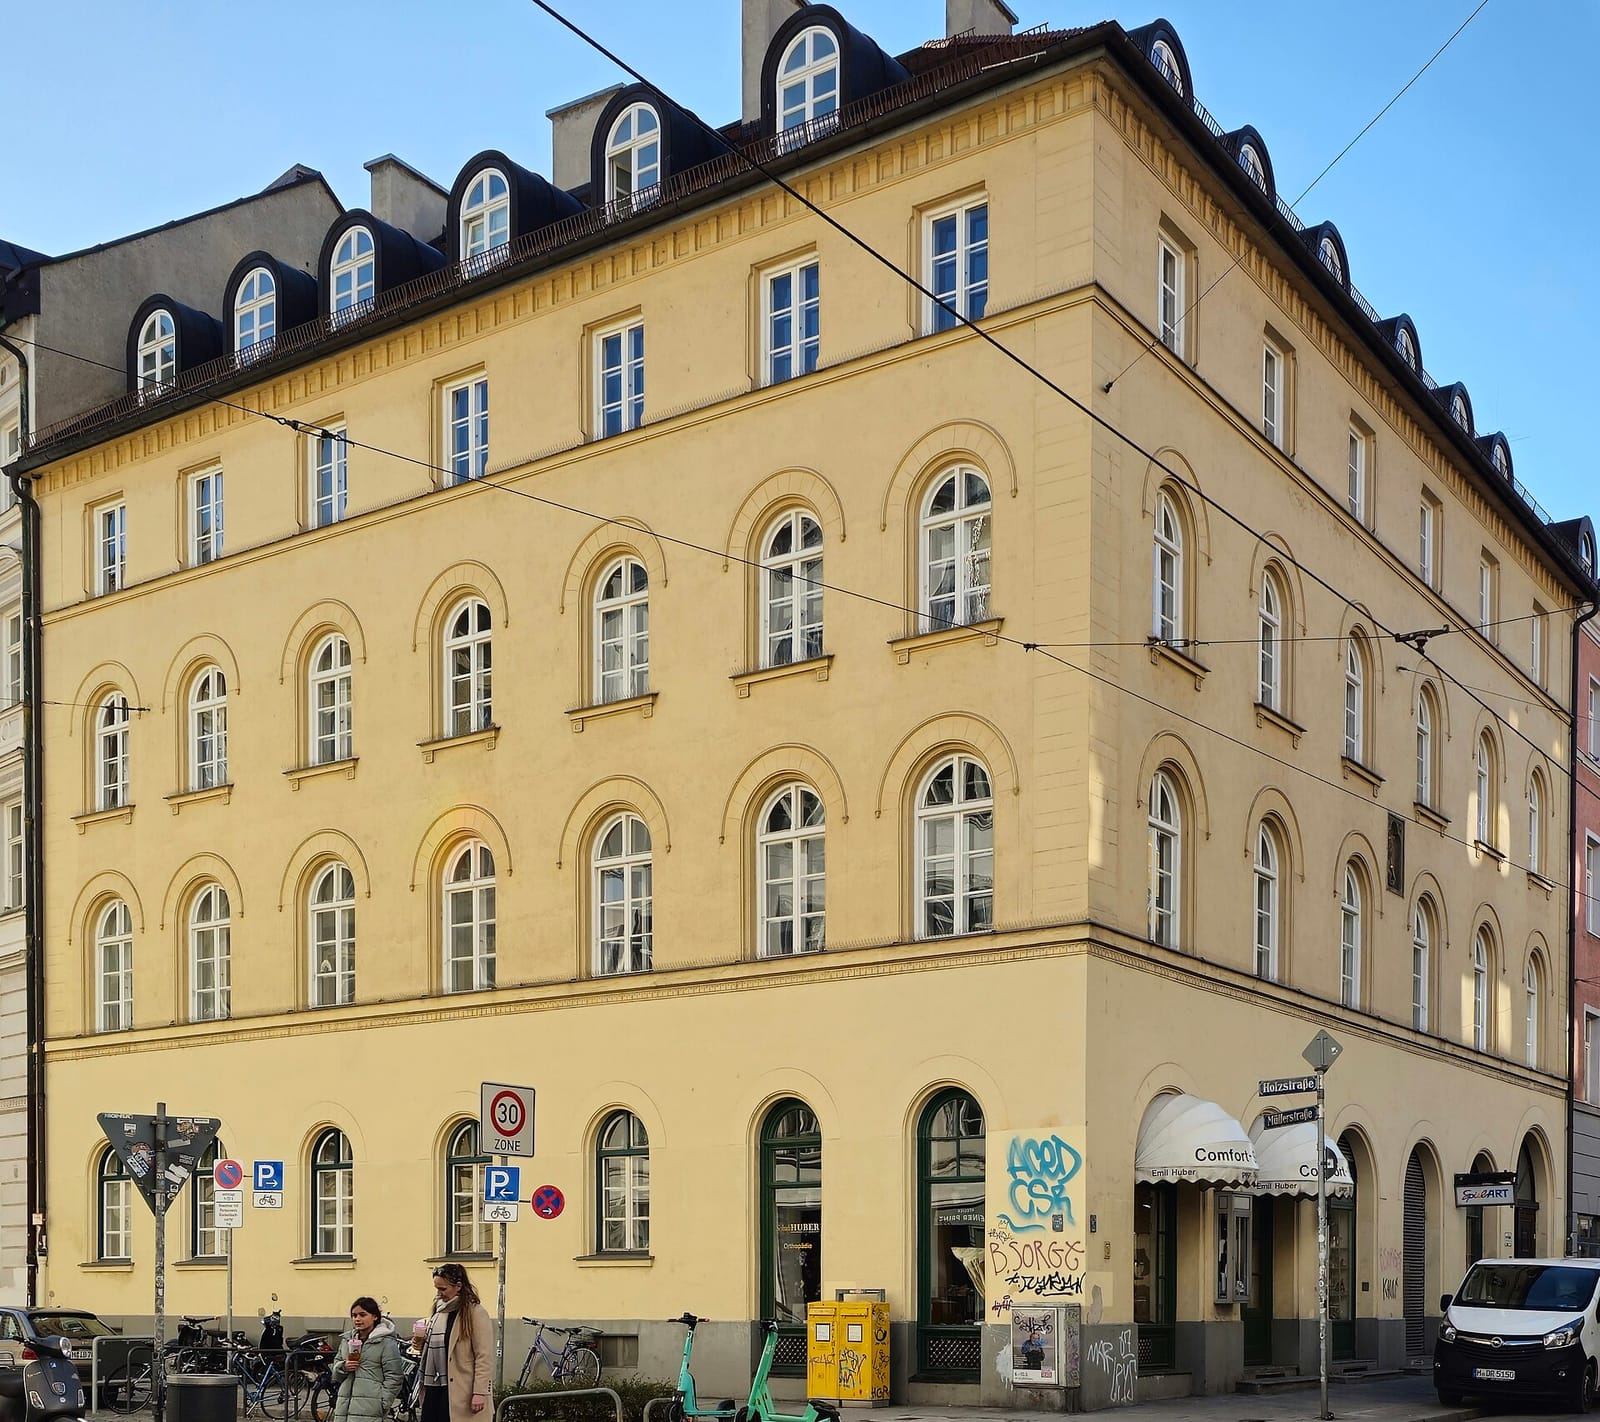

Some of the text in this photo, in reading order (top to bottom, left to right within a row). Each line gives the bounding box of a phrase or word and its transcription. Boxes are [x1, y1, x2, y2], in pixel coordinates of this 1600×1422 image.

[1263, 1078, 1314, 1093] Holzstraße
[498, 1103, 519, 1125] 30
[1267, 1109, 1313, 1126] Müllerstraße
[494, 1138, 521, 1152] ZONE
[258, 1164, 275, 1188] P
[1152, 1168, 1196, 1177] Emil Huber
[490, 1170, 510, 1198] P
[1256, 1182, 1298, 1190] Emil Huber
[790, 1223, 820, 1232] HUBER
